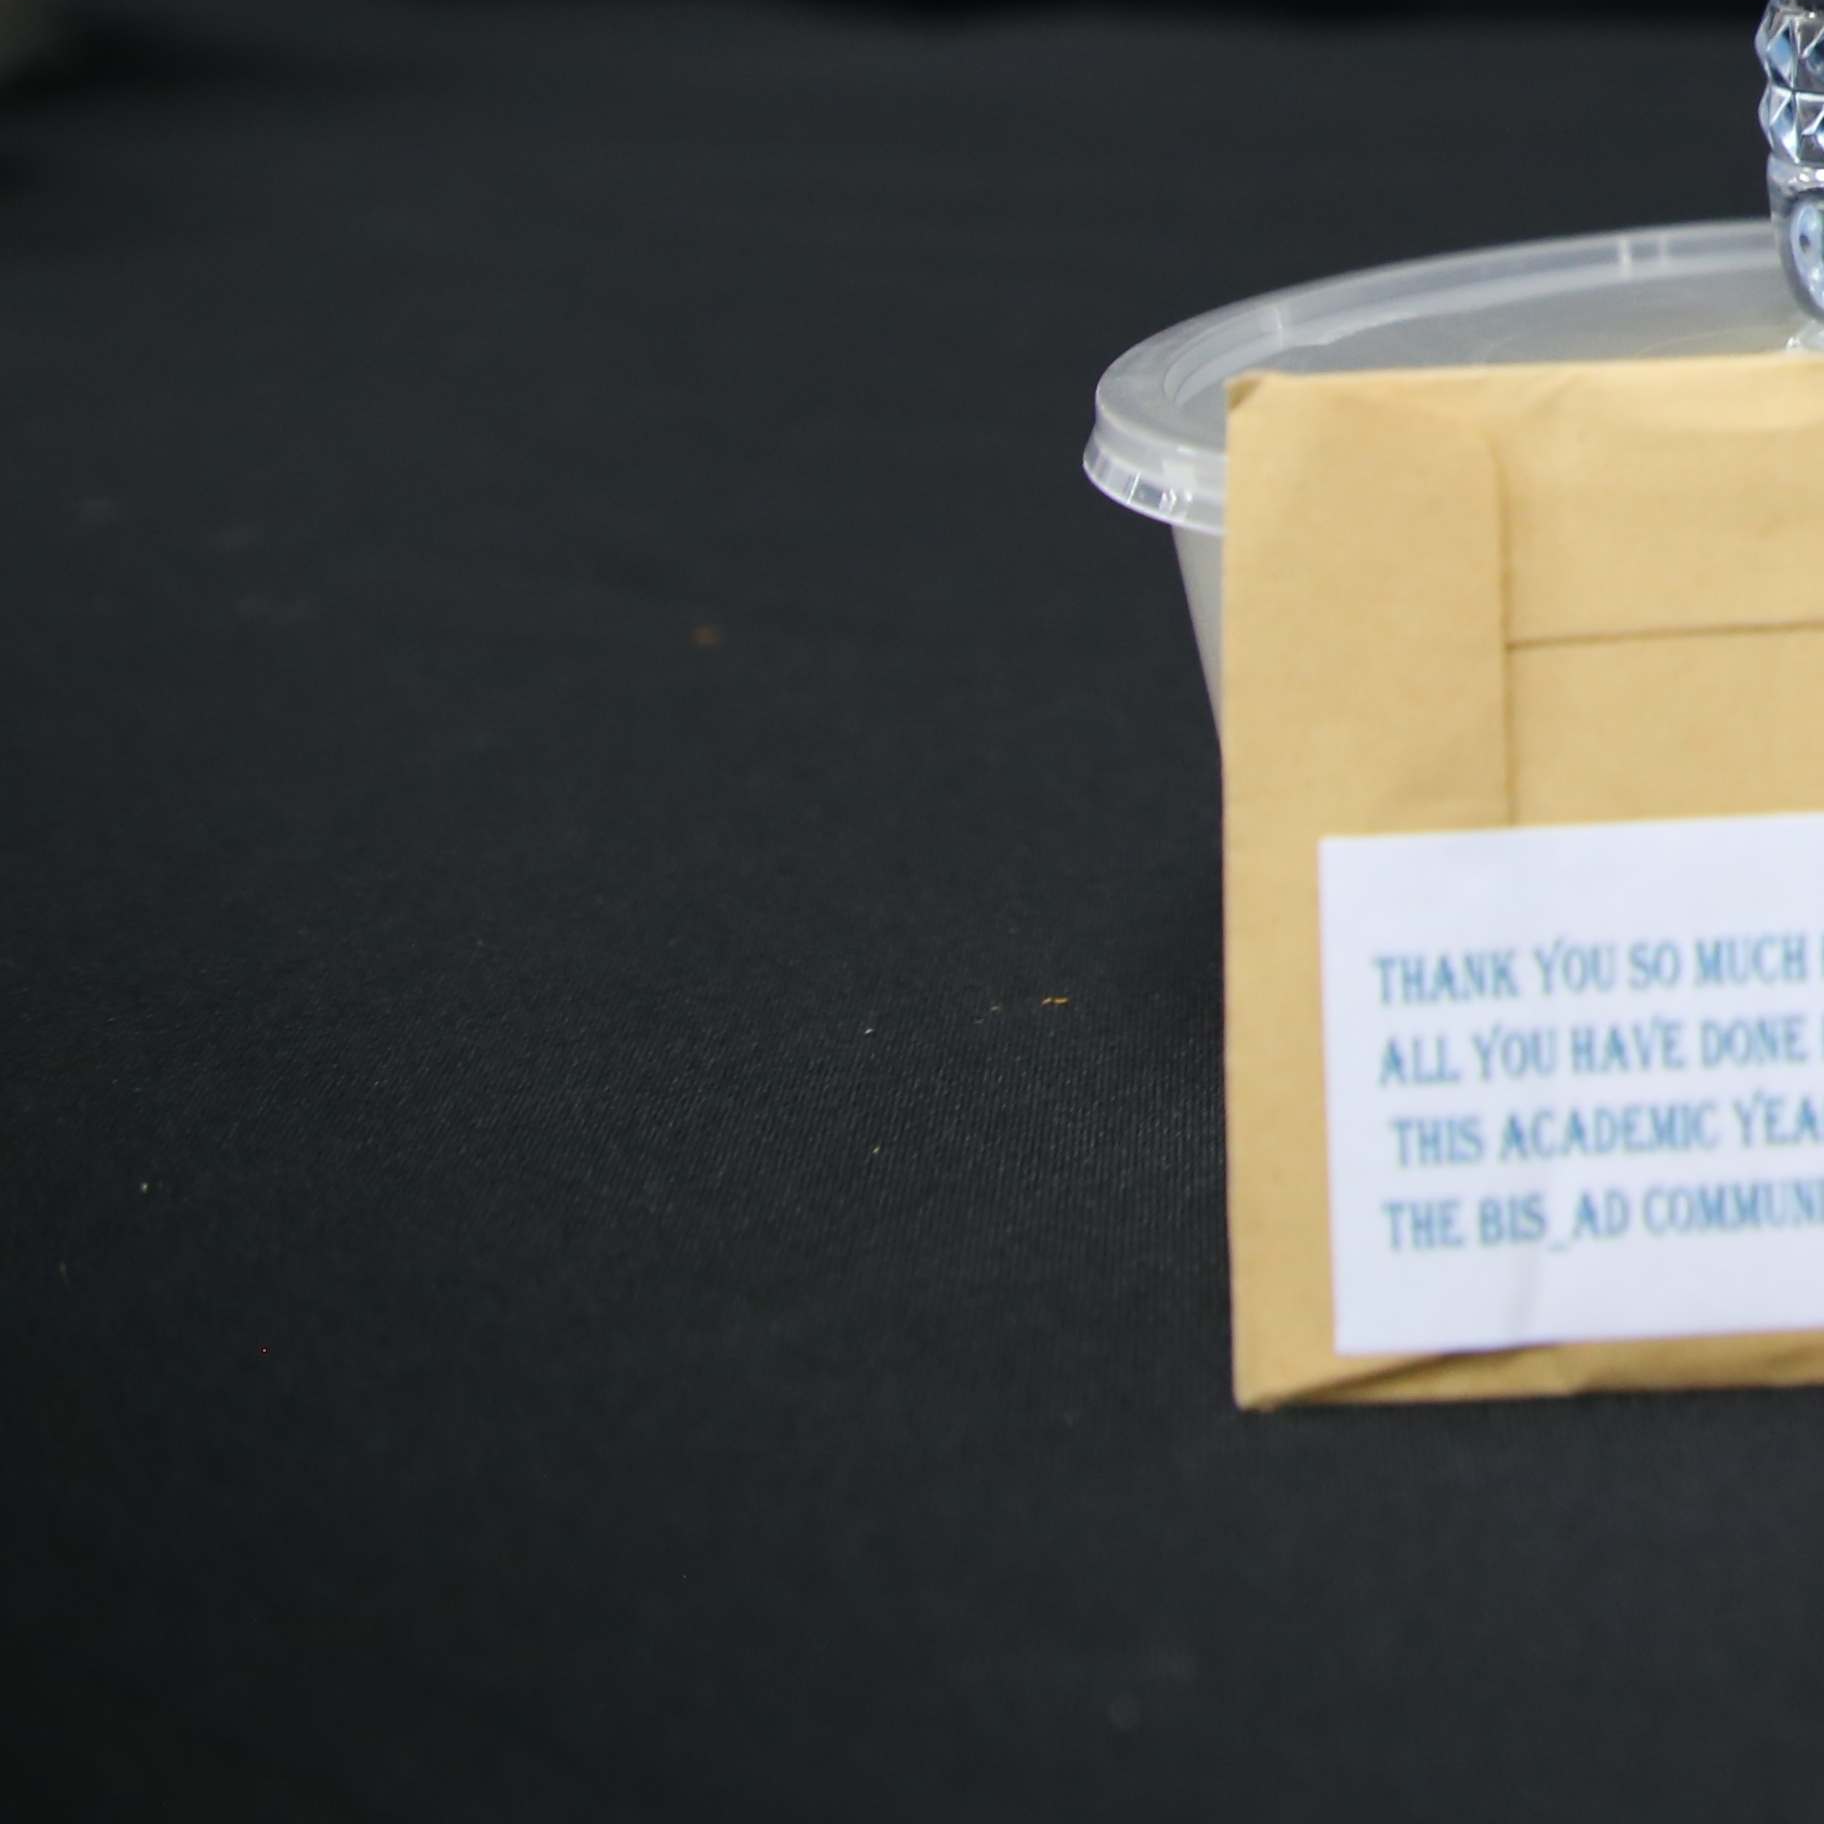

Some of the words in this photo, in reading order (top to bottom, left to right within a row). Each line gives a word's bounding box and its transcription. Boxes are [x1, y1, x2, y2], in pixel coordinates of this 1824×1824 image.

[1372, 951, 1520, 1003] THANK
[1533, 942, 1617, 993] YOU
[1628, 943, 1682, 985] SO
[1694, 937, 1808, 984] MUCH
[1379, 1039, 1460, 1084] ALL
[1472, 1028, 1554, 1078] YOU
[1569, 1022, 1685, 1072] HAVE
[1700, 1017, 1807, 1067] DONE
[1392, 1118, 1485, 1165] THIS
[1498, 1103, 1714, 1161] ACADEMIC
[1384, 1200, 1464, 1248] THE
